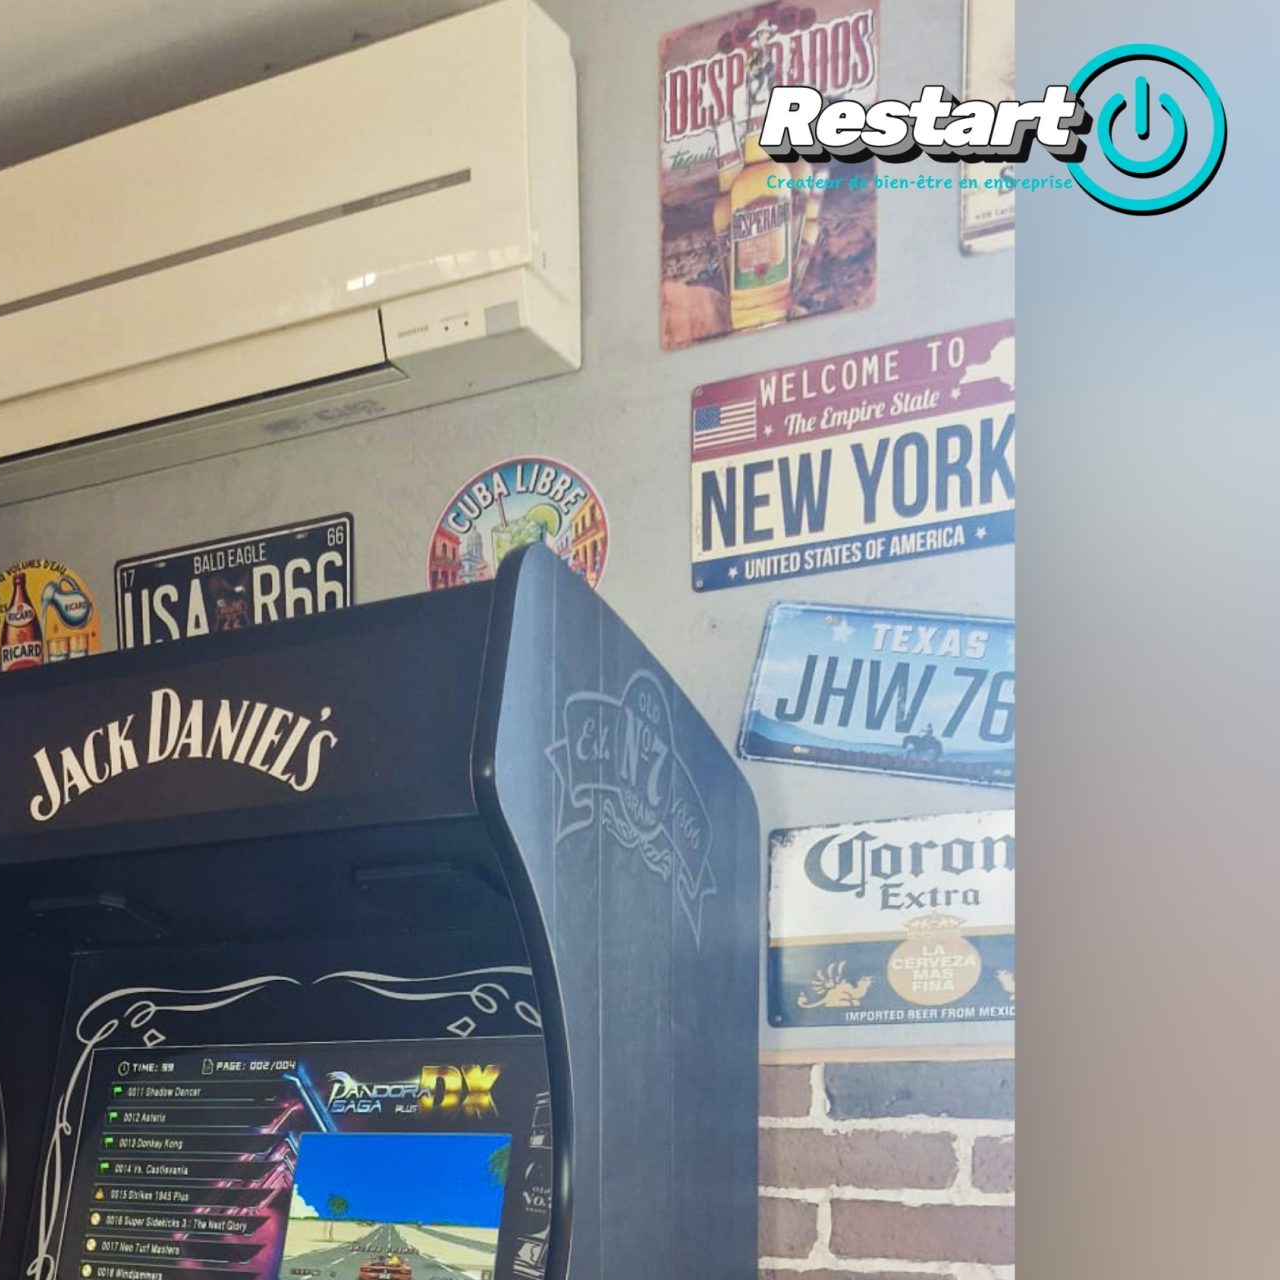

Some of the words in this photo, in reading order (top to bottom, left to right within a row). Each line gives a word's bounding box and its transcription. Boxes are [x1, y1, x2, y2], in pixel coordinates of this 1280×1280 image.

[760, 351, 900, 409] WELCOME
[927, 337, 965, 370] TO
[784, 411, 816, 437] The
[820, 401, 886, 434] Empire
[890, 389, 940, 416] State
[701, 448, 832, 552] NEW
[851, 412, 1015, 524] YORK
[448, 472, 508, 534] CUBA
[514, 464, 586, 513] LIBRE
[327, 526, 345, 547] 66
[193, 552, 225, 575] BALD
[228, 543, 267, 567] EAGLE
[744, 550, 801, 580] UNITED
[803, 542, 862, 573] STATES
[865, 538, 887, 562] OF
[889, 525, 965, 558] AMERICA
[122, 569, 136, 588] 17
[124, 578, 210, 649] USA
[252, 551, 344, 625] R66
[872, 622, 990, 659] TEXAS
[2, 644, 42, 662] RICARD
[775, 652, 936, 733] JHW
[940, 667, 1015, 743] 76
[639, 692, 661, 725] OLD
[29, 714, 139, 822] JACK
[147, 688, 338, 793] DANIEL'S
[804, 830, 1015, 899] Coron
[880, 883, 981, 911] Extra
[922, 943, 945, 956] LA
[891, 954, 977, 970] CERVEZA
[912, 967, 955, 980] MAS
[912, 979, 955, 992] FINA
[845, 1009, 905, 1022] IMPORTED
[907, 1008, 938, 1020] BEER
[941, 1006, 976, 1019] FROM
[979, 1005, 1015, 1018] MEXIC
[132, 1063, 158, 1073] TIME:
[216, 1061, 246, 1071] PAGE:
[145, 1086, 173, 1097] Shadow
[175, 1086, 202, 1097] Dancer
[420, 1064, 502, 1118] DX
[331, 1100, 382, 1113] SAGA
[394, 1104, 420, 1113] PLUS
[141, 1112, 166, 1122] Asterix
[136, 1138, 162, 1150] Donkey
[163, 1138, 183, 1150] Kong
[145, 1164, 188, 1176] Castlevania
[173, 1191, 190, 1201] Plus
[123, 1216, 145, 1229] Super
[145, 1217, 180, 1228] Sidekicks
[193, 1218, 207, 1229] The
[226, 1219, 248, 1233] Glory
[119, 1242, 134, 1252] Neo
[135, 1242, 150, 1253] Turf
[150, 1243, 180, 1255] Masters
[115, 1267, 163, 1280] Windjammers
